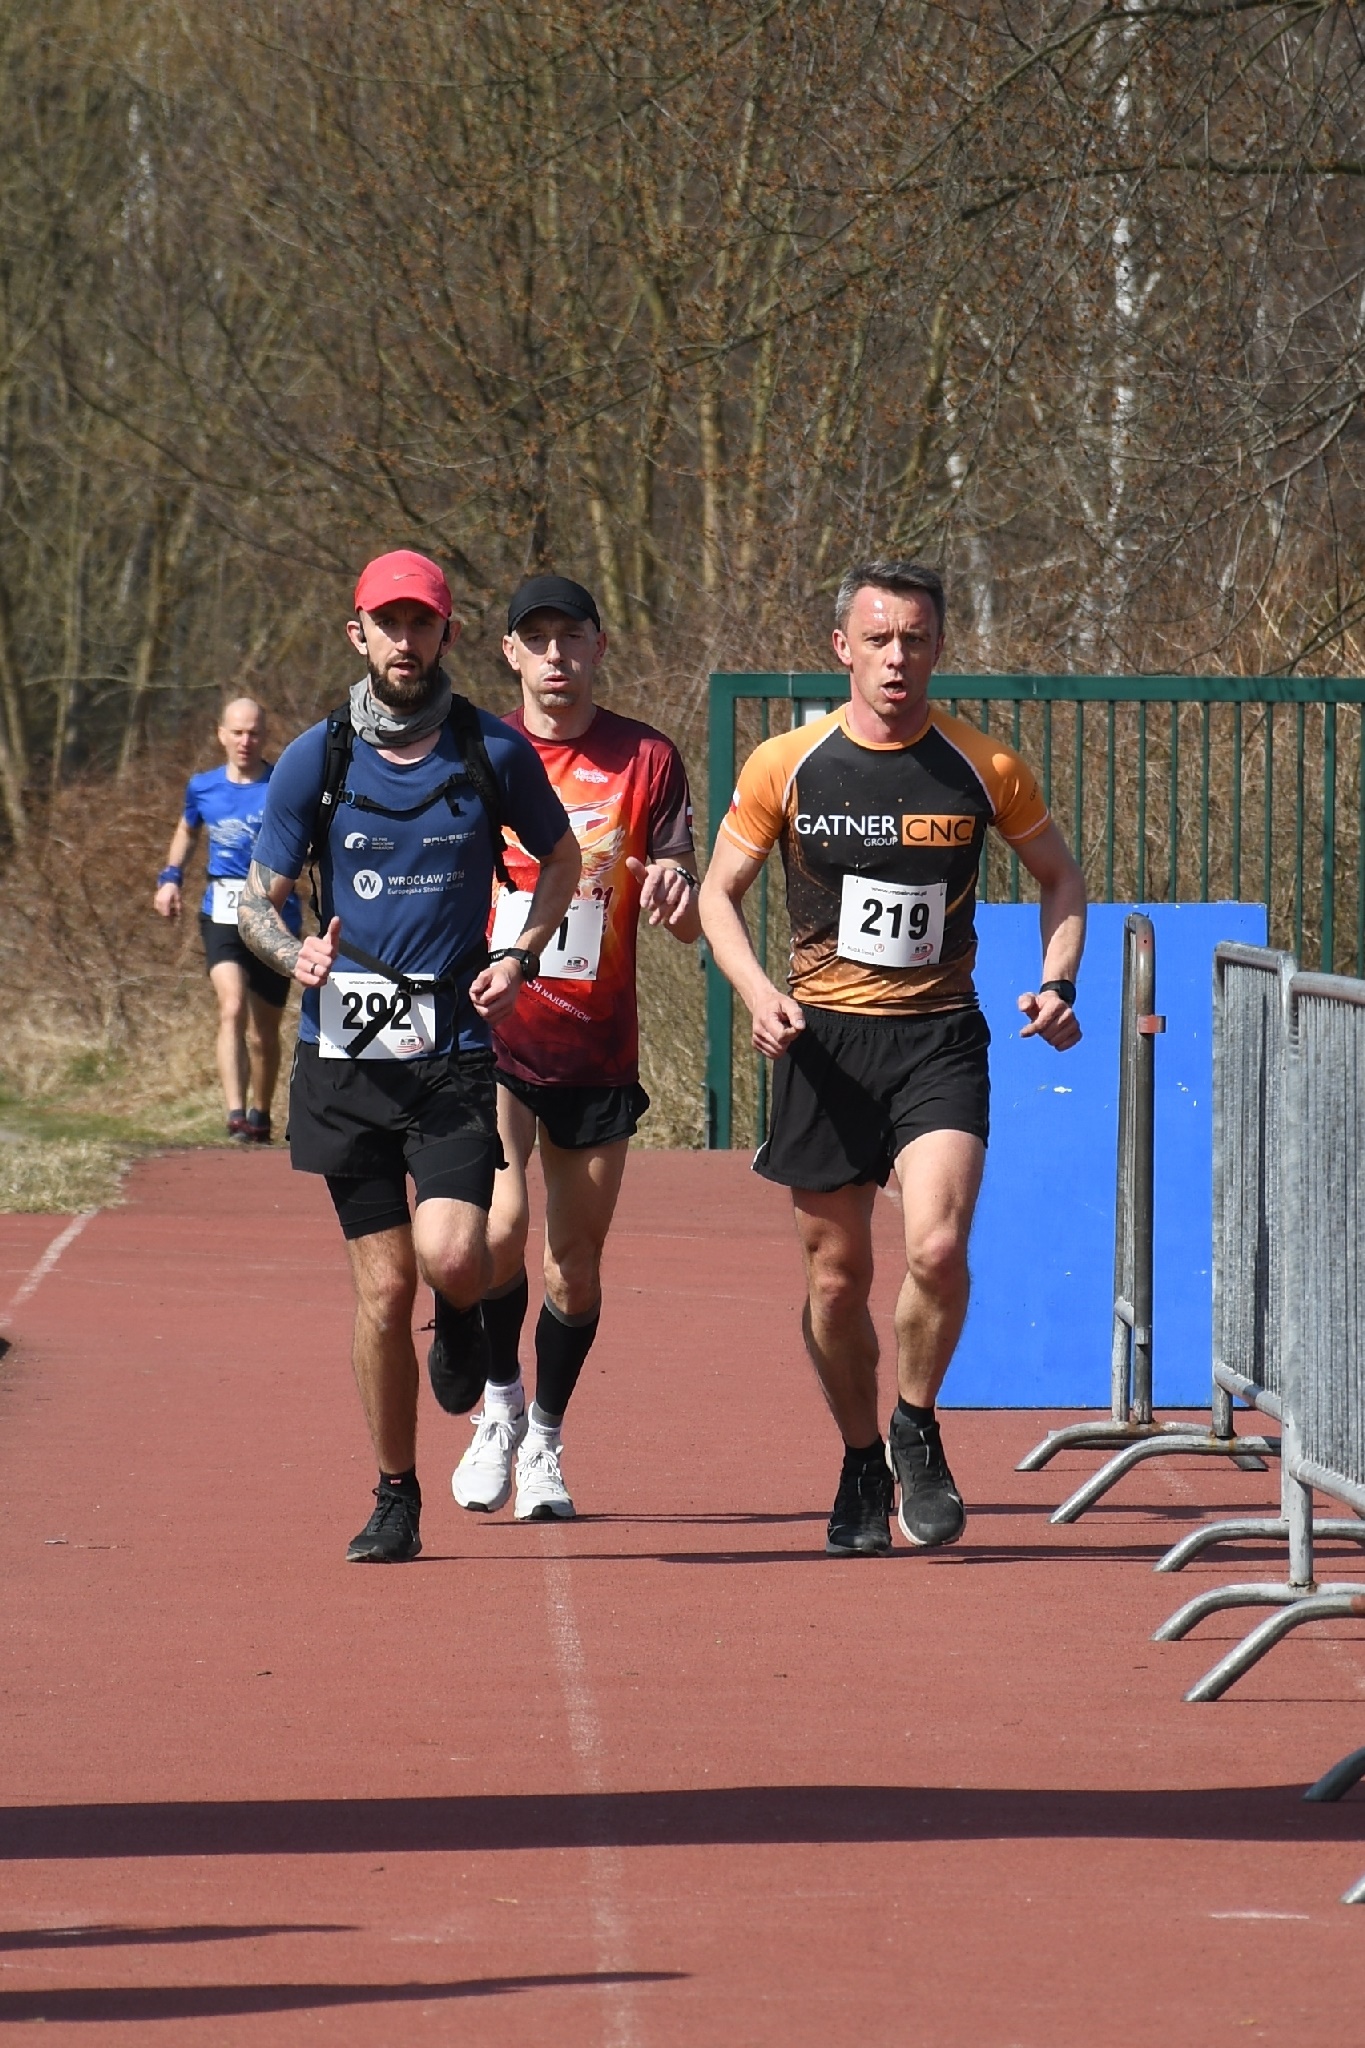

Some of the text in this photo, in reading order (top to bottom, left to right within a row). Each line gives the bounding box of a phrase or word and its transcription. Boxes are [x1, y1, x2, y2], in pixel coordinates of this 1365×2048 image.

[794, 814, 972, 842] GATNER CNC
[863, 836, 899, 847] GROUP
[387, 873, 443, 886] WROCŁAW
[859, 898, 930, 940] 219
[341, 991, 412, 1030] 292
